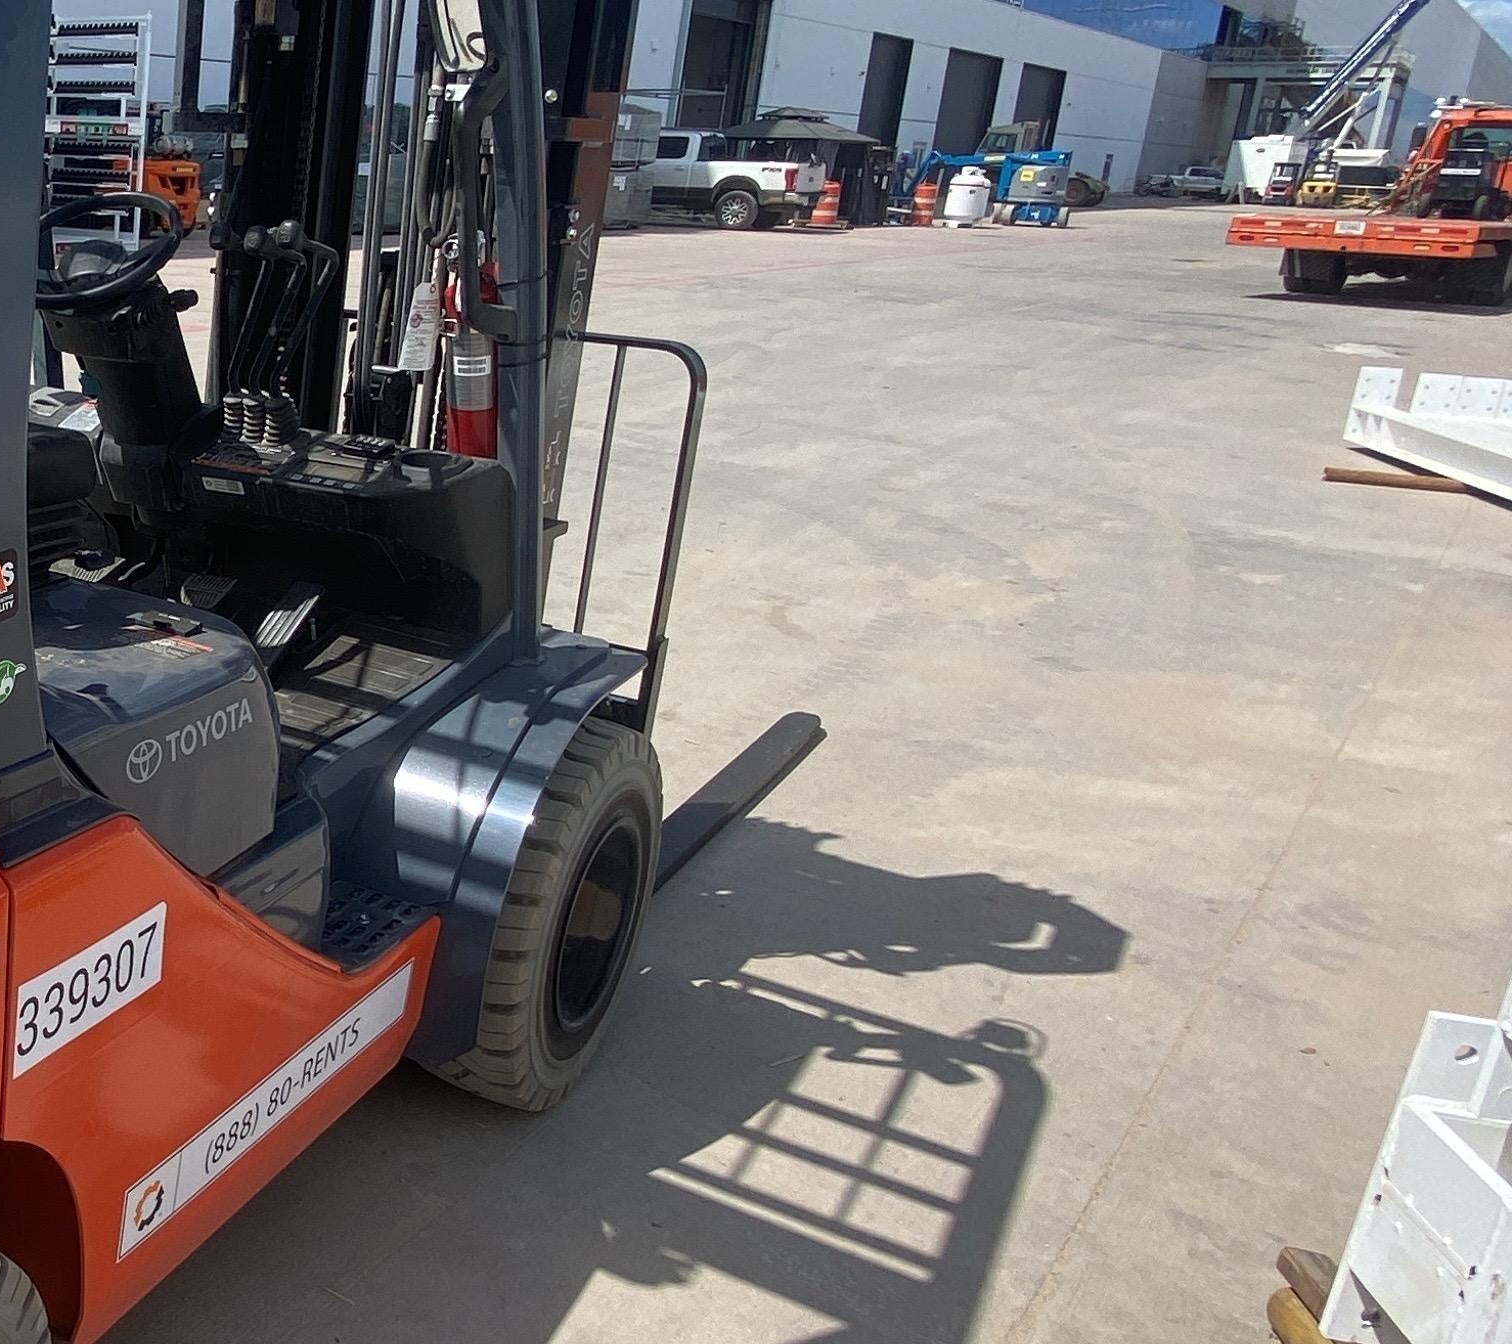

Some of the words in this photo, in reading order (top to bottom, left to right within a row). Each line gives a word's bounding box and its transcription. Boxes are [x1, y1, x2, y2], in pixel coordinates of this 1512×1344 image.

[165, 698, 253, 762] TOYOTA
[16, 921, 158, 1057] 339307
[204, 1102, 260, 1174] (888)
[266, 1017, 361, 1117] 80-RENTS
